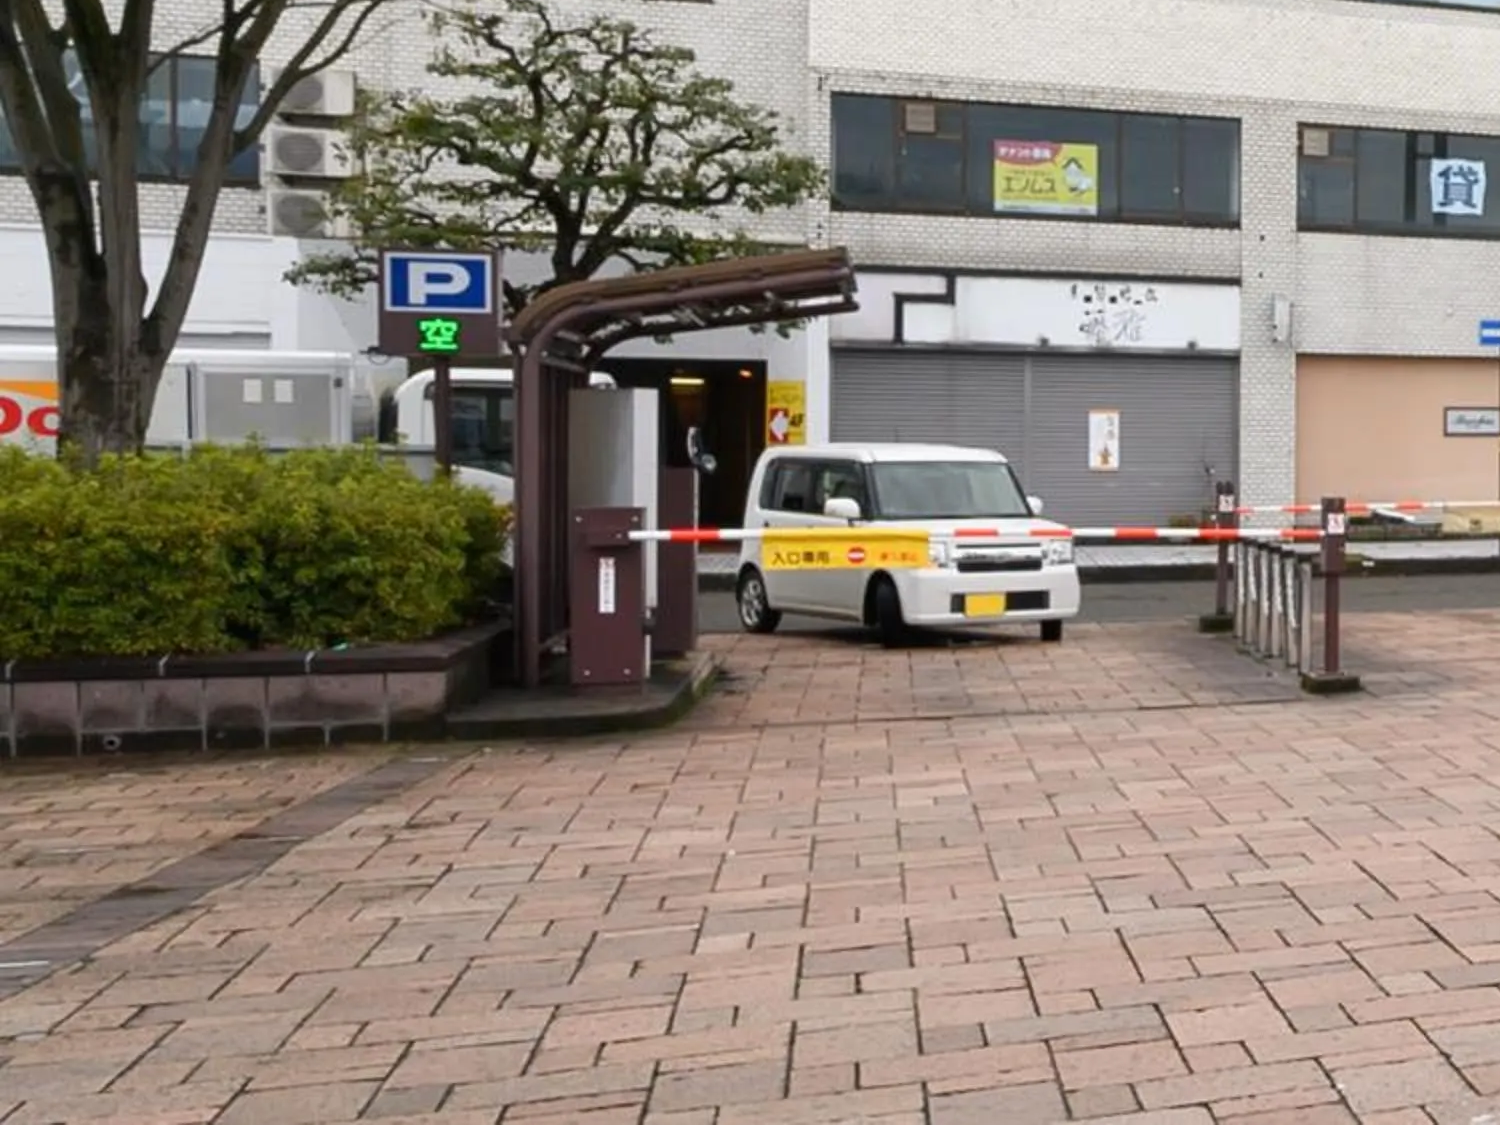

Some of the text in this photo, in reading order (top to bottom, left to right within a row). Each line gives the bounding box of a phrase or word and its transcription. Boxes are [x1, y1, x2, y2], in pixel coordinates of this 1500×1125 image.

[1437, 164, 1479, 208] 貸
[408, 260, 471, 305] P
[420, 318, 458, 350] 空
[771, 550, 831, 565] 入口専用
